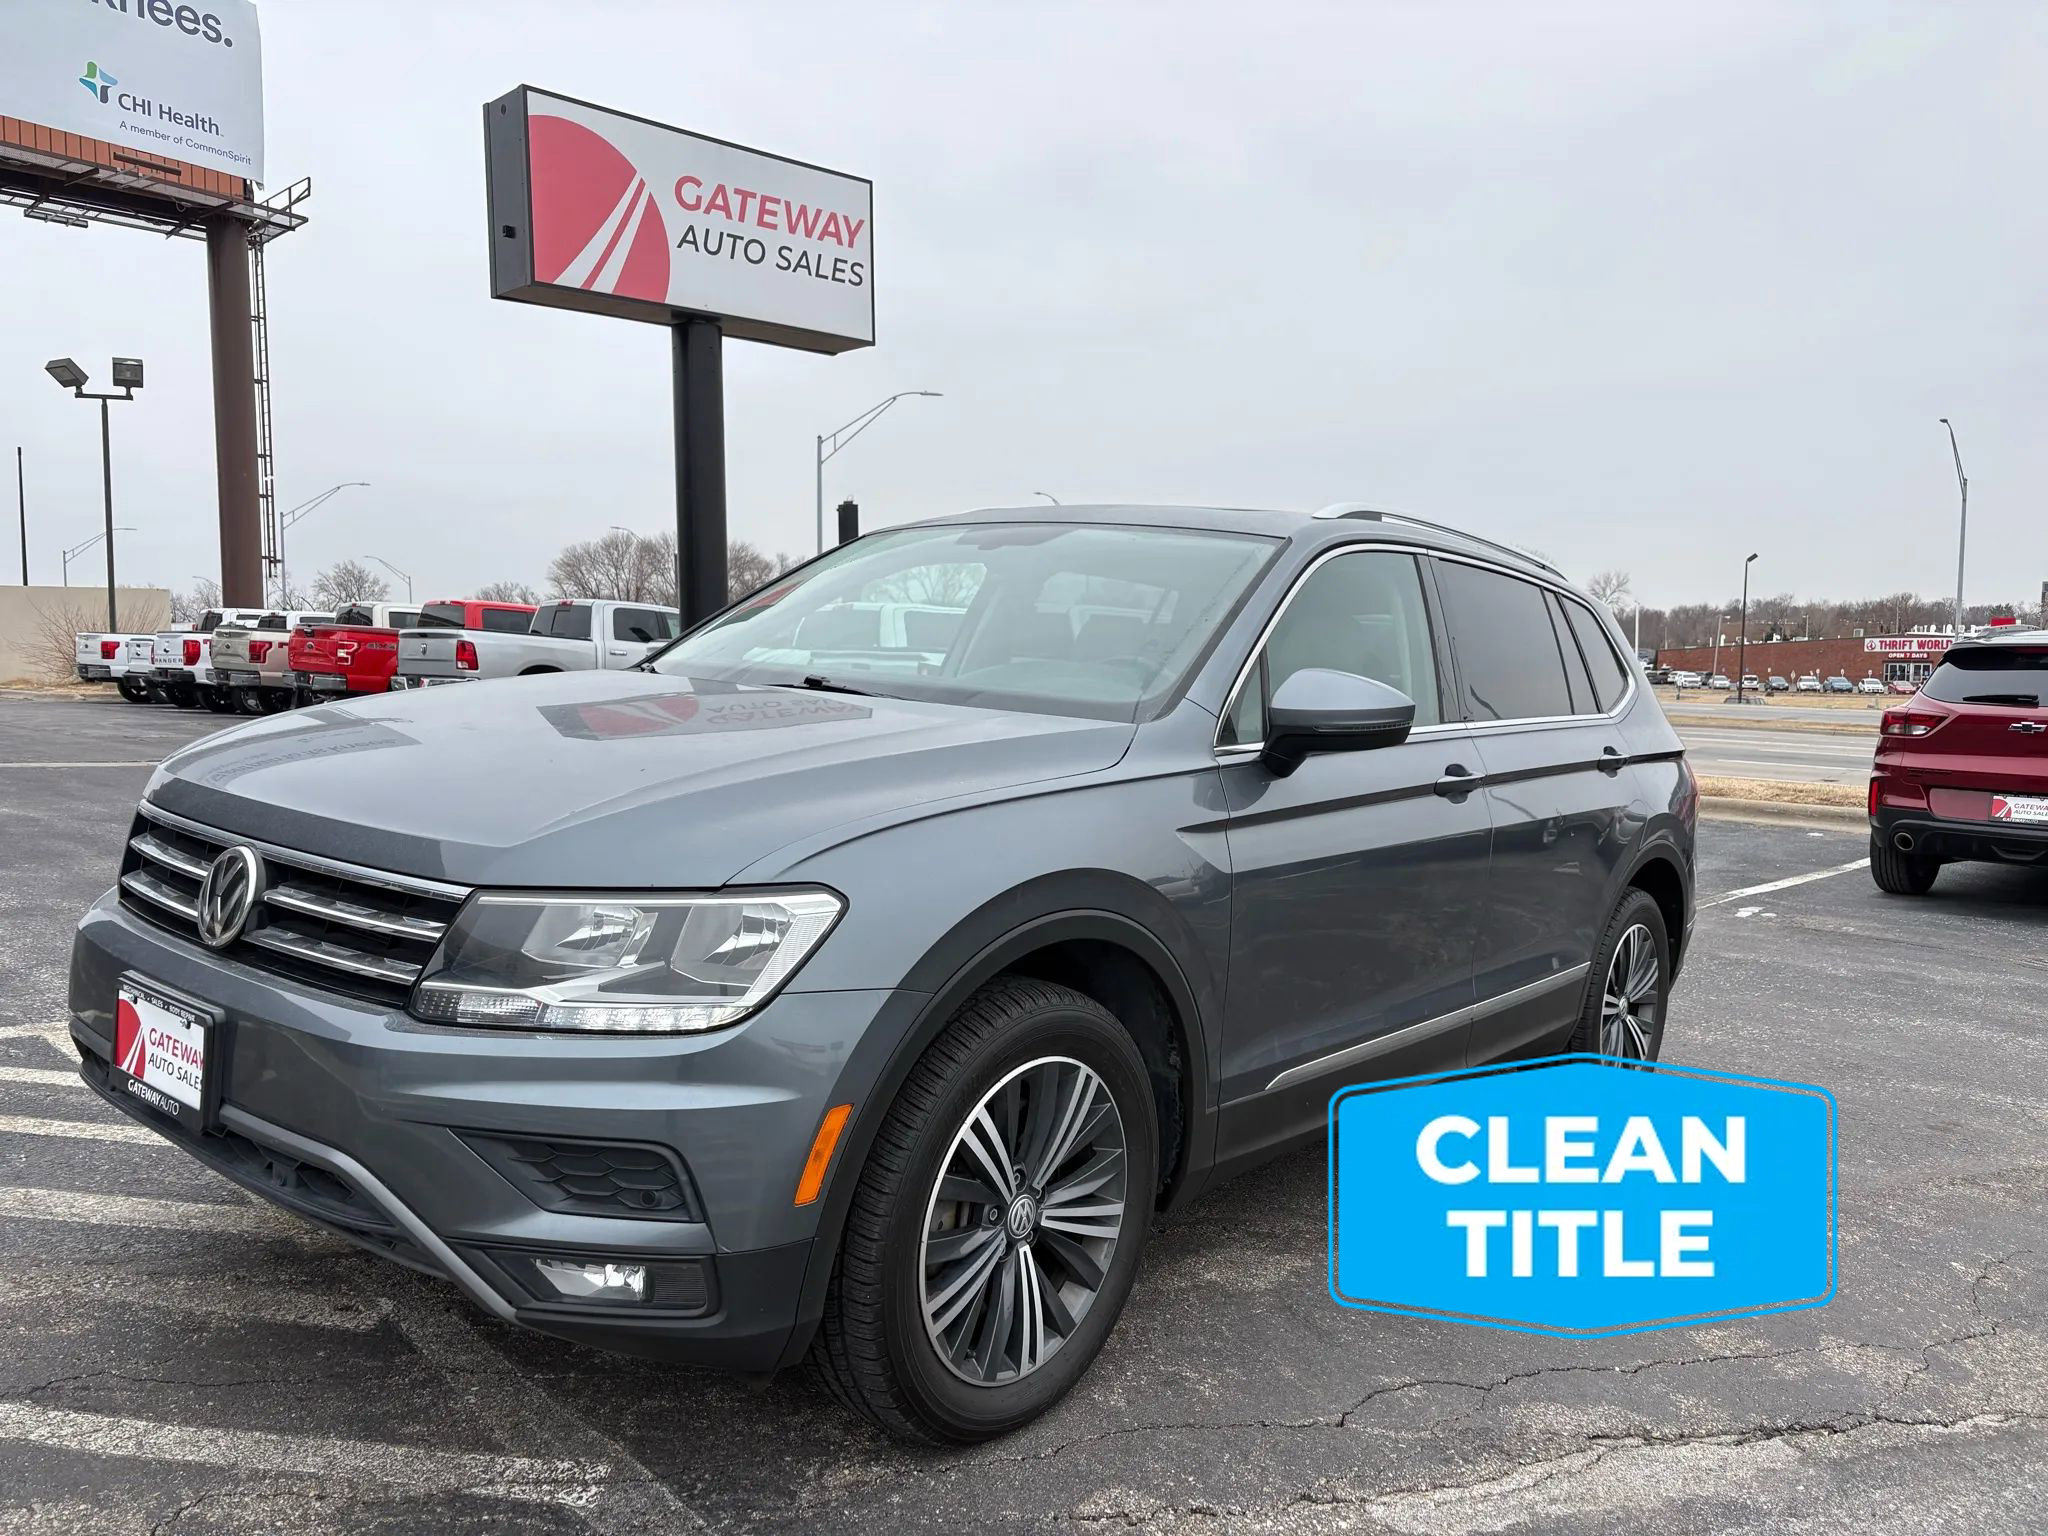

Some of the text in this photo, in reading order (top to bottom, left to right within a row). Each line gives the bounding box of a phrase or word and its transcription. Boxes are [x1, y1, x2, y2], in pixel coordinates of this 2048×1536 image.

[91, 0, 233, 47] nees.
[118, 93, 220, 137] CHI Health
[119, 120, 252, 166] A member of CommonSpirit
[674, 175, 865, 249] GATEWAY
[676, 224, 865, 287] AUTO SALES
[1878, 639, 1914, 650] THRIFT
[148, 1053, 175, 1076] AUTO
